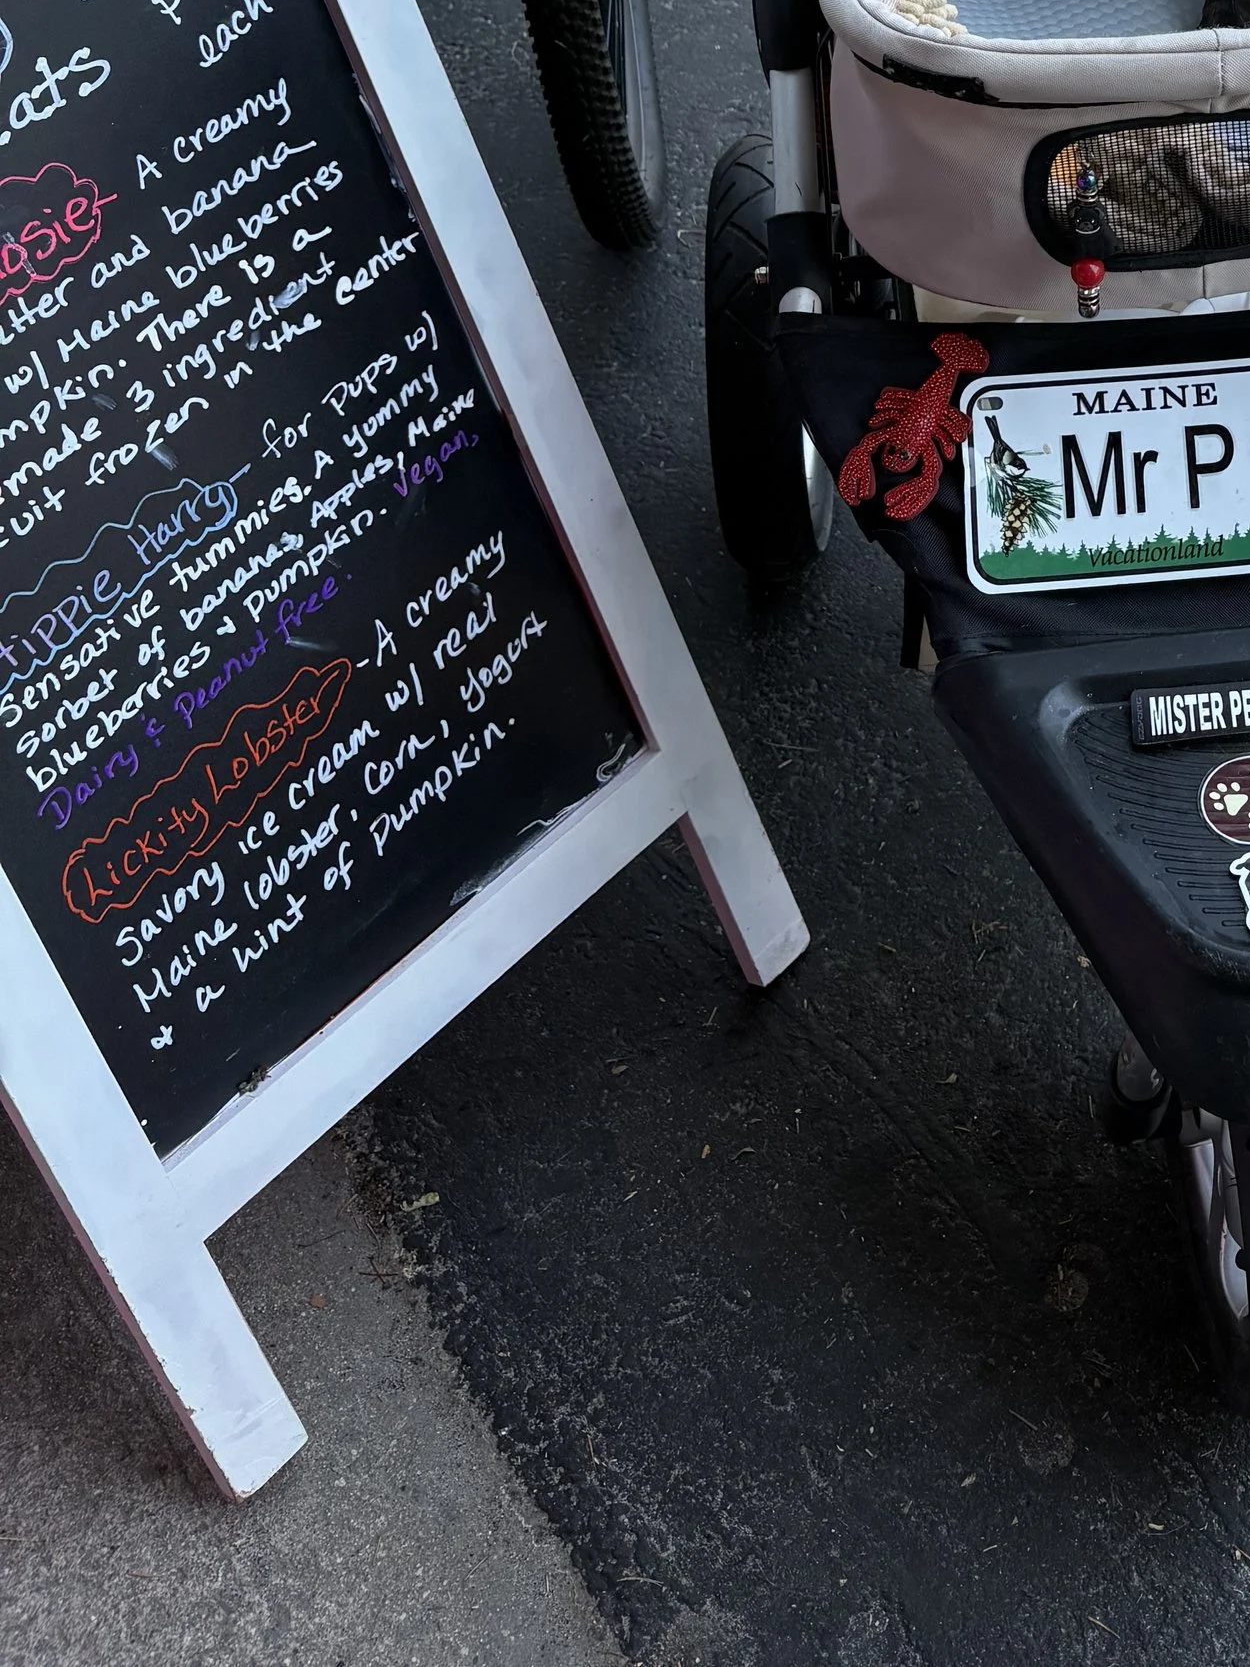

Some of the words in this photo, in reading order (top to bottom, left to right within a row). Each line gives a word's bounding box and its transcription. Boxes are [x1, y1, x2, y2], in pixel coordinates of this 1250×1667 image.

[0, 47, 111, 146] ats
[135, 154, 163, 190] A
[173, 77, 292, 163] creamy
[4, 350, 50, 394] w/
[57, 290, 160, 363] Maine
[165, 160, 344, 290] blueberries
[90, 234, 151, 289] and
[161, 140, 317, 235] banana
[0, 358, 127, 448] mpkin.
[135, 284, 232, 352] There
[238, 253, 275, 284] is
[291, 225, 333, 251] a
[0, 417, 102, 508] made
[126, 380, 155, 413] 3
[162, 251, 336, 388] ingredient
[85, 396, 210, 486] frozen
[223, 361, 253, 389] in
[262, 312, 322, 353] the
[335, 231, 419, 306] center
[1072, 382, 1219, 417] MAINE
[127, 484, 236, 566] Harry
[261, 412, 311, 459] for
[404, 309, 439, 351] w/
[313, 449, 334, 480] A
[343, 363, 440, 458] yummy
[1060, 429, 1159, 520] Mr
[1183, 422, 1236, 510] P
[16, 668, 118, 757] sorbet
[137, 625, 166, 666] of
[407, 388, 475, 447] Maine
[1087, 534, 1225, 569] Vacationland
[26, 641, 211, 790] blueberries
[205, 668, 341, 806] Lobster
[373, 619, 398, 667] A
[406, 530, 506, 628] creamy
[238, 810, 281, 855] ice
[288, 719, 380, 811] cream
[384, 662, 424, 712] w/
[433, 591, 497, 670] real
[1148, 691, 1227, 737] MISTER
[37, 743, 139, 830] Dairy
[132, 917, 238, 1013] Maine
[195, 984, 226, 1013] a
[232, 892, 307, 973] hint
[323, 840, 354, 891] of
